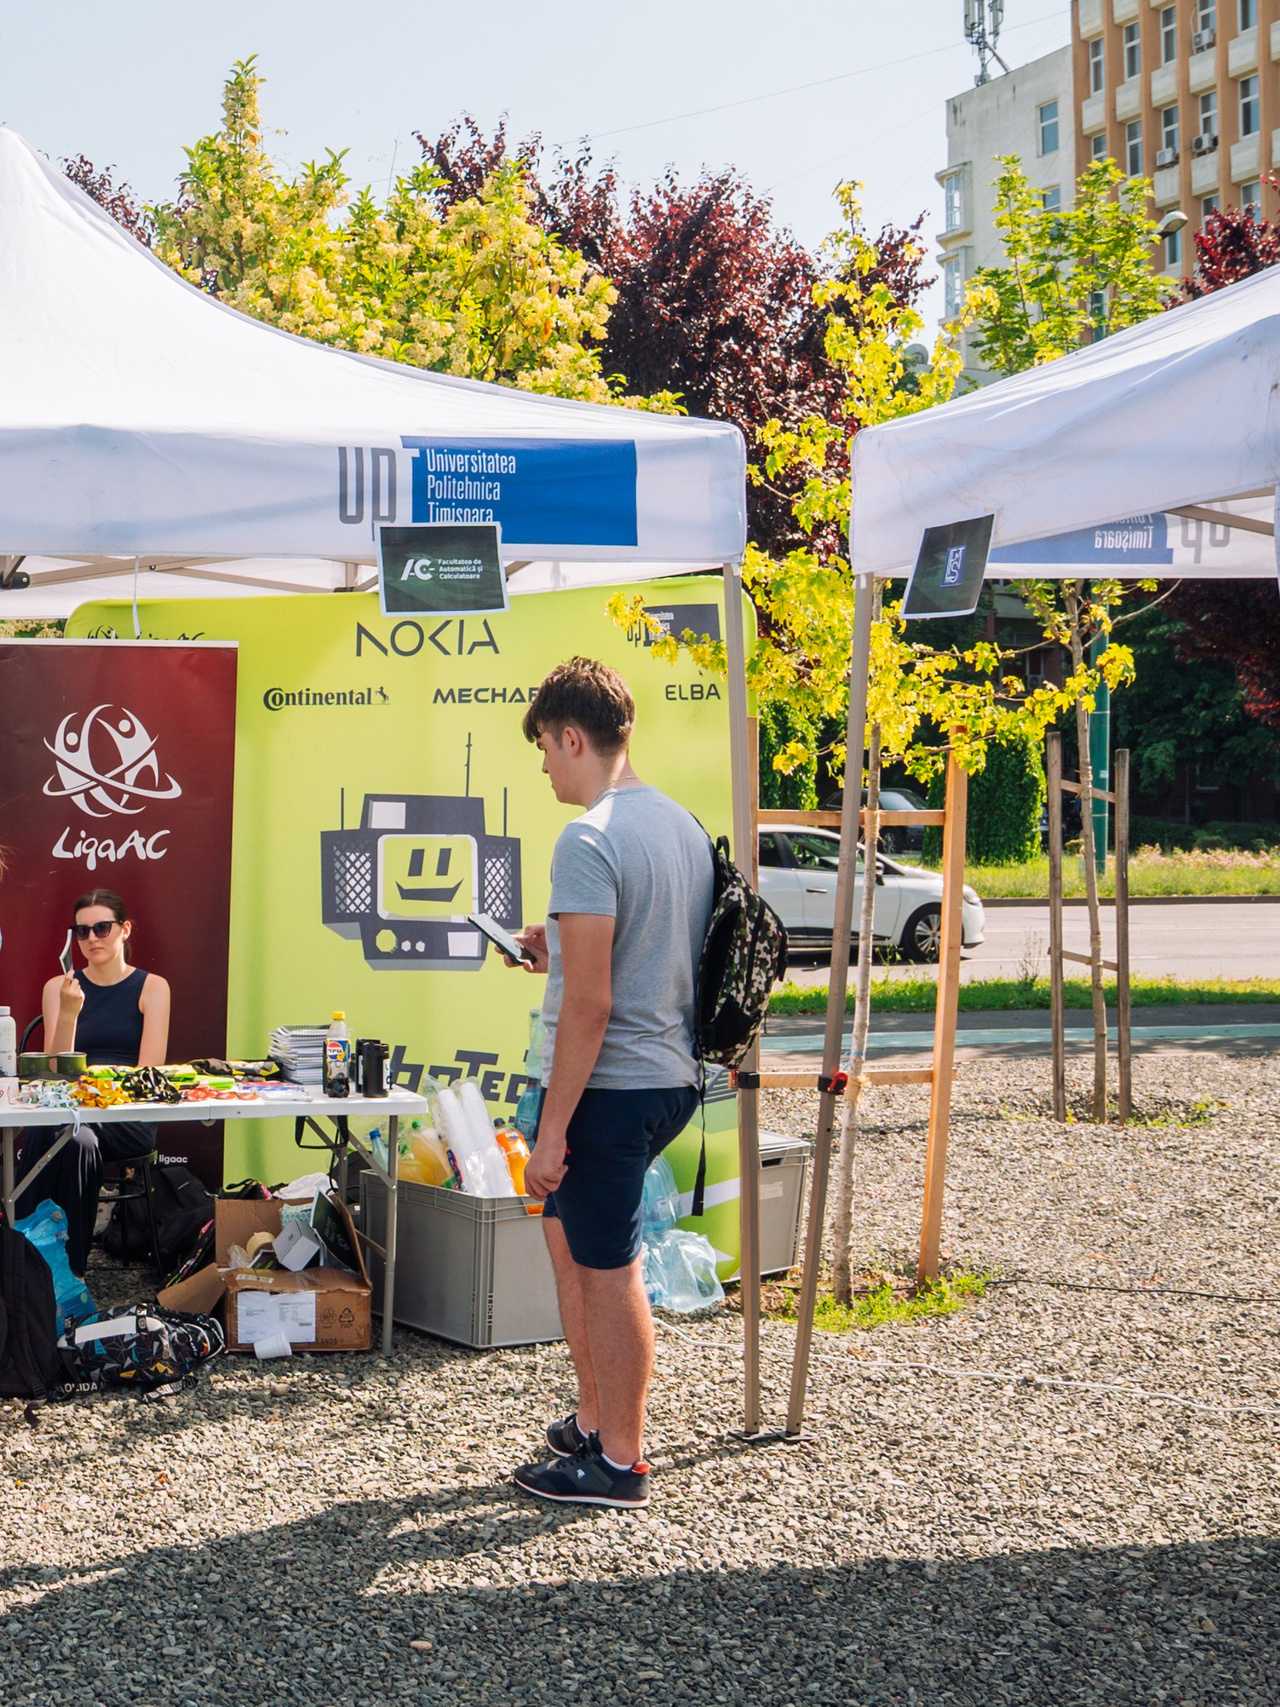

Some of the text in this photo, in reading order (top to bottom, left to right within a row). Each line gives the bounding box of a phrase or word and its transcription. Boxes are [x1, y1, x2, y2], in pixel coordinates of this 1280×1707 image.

[426, 448, 516, 474] Universitatea
[427, 475, 501, 501] Politehnica
[356, 618, 500, 658] NOKIA
[263, 686, 373, 712] Continental
[665, 683, 721, 701] ELBA
[52, 826, 171, 871] LigaAC
[158, 1154, 188, 1165] ligaac
